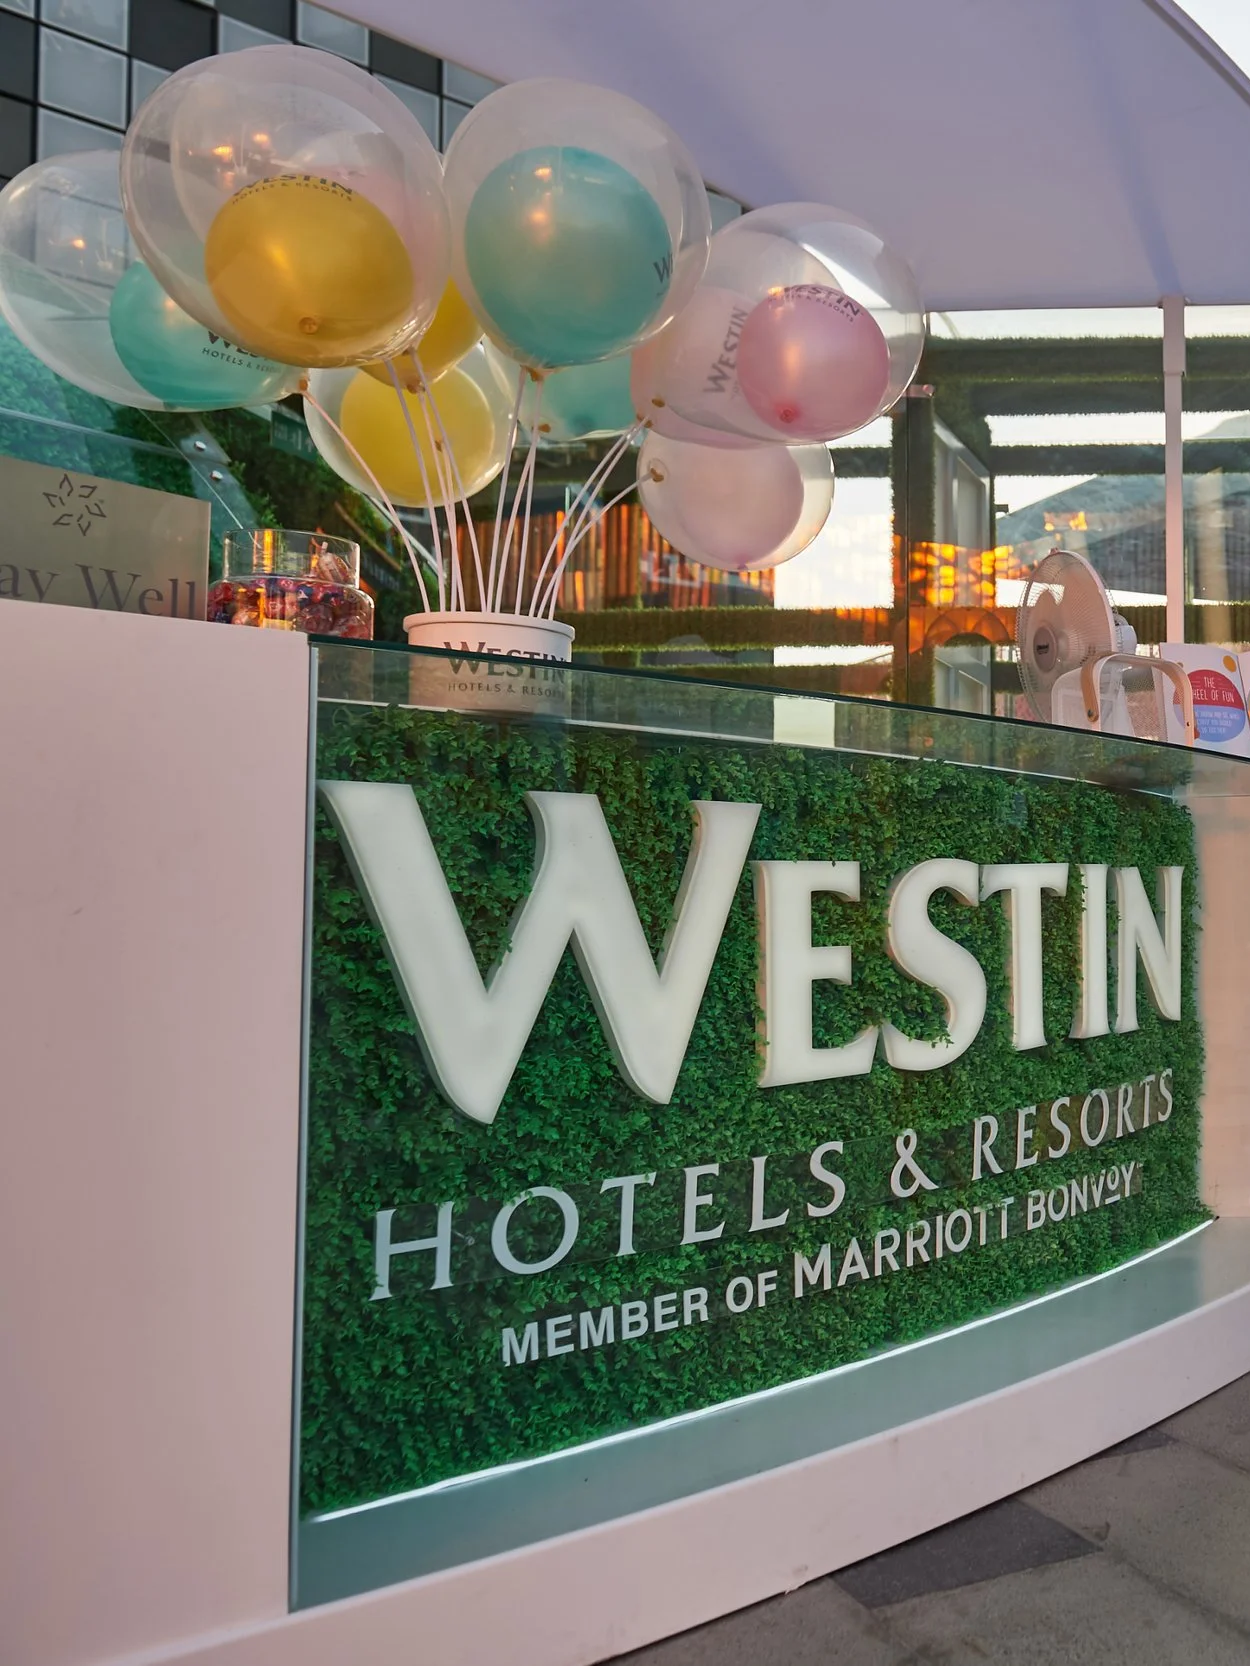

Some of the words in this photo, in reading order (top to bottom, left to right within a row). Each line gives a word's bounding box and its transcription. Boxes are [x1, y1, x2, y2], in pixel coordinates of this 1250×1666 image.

[201, 346, 244, 367] HOTELS
[74, 562, 197, 621] Well
[443, 641, 567, 684] WESTIN
[1203, 675, 1217, 689] THE
[447, 681, 502, 694] HOTELS
[1192, 687, 1208, 701] HEEL
[1210, 690, 1219, 701] OF
[1221, 690, 1235, 704] FUN
[317, 779, 1185, 1125] WESTIN
[368, 1140, 846, 1301] HOTELS
[890, 1128, 939, 1198] &
[971, 1067, 1174, 1181] RESORTS
[502, 1286, 709, 1367] MEMBER
[725, 1269, 778, 1313] OF
[794, 1196, 1015, 1298] MARRIOTT
